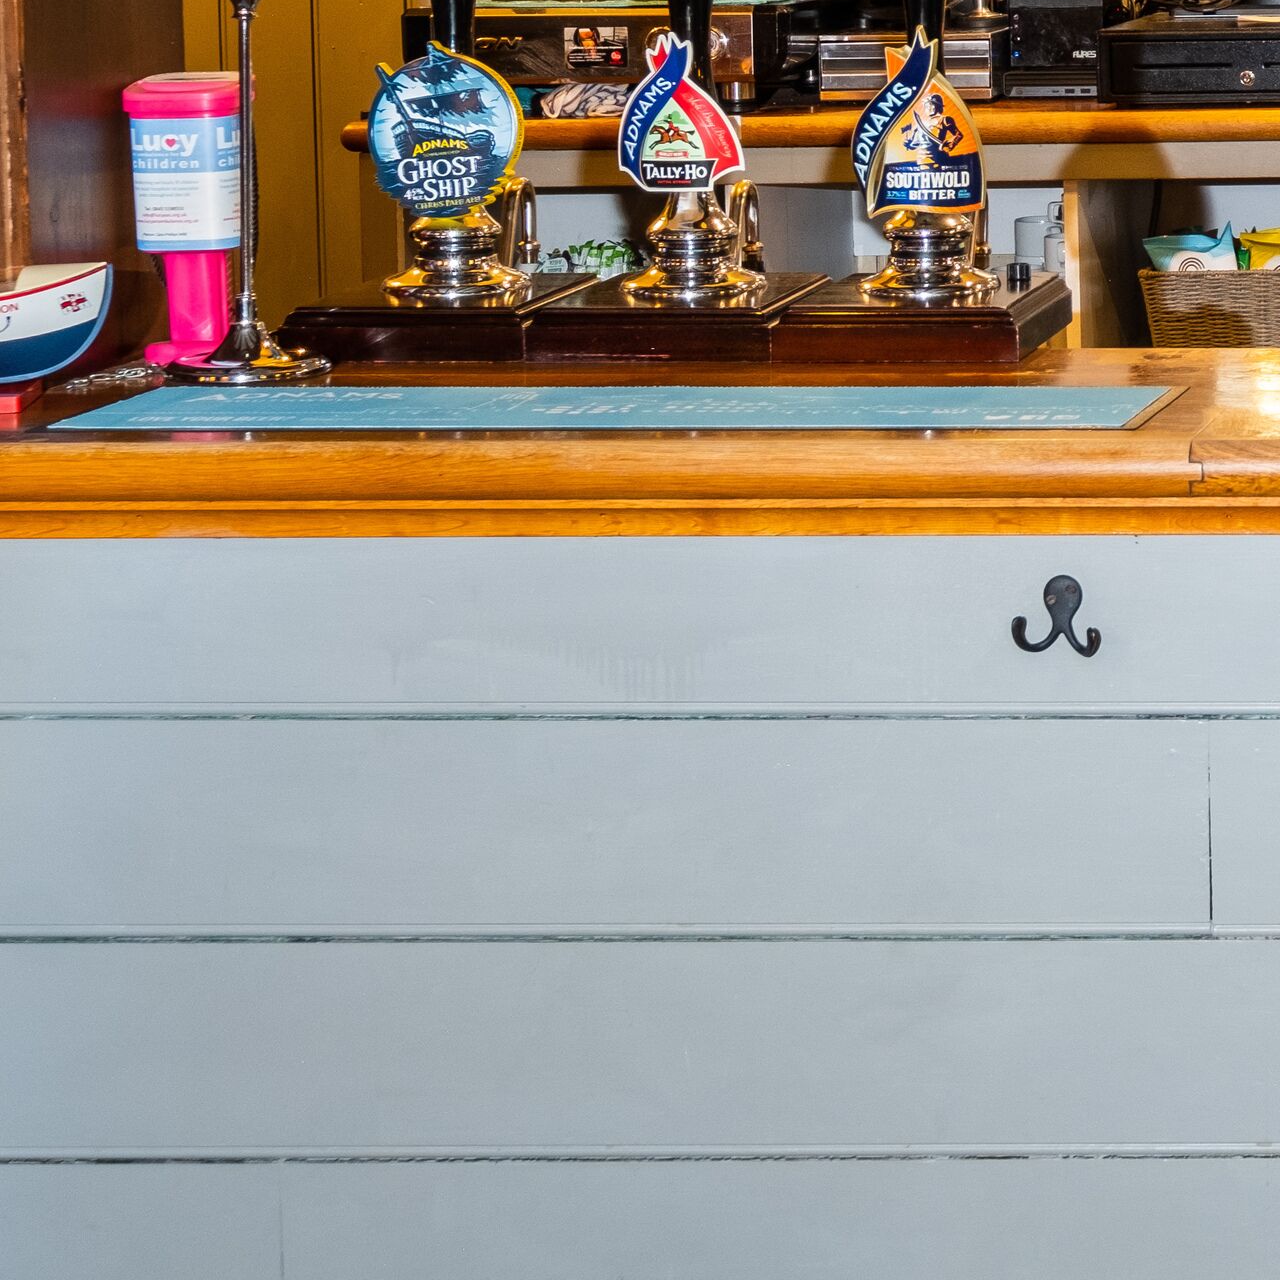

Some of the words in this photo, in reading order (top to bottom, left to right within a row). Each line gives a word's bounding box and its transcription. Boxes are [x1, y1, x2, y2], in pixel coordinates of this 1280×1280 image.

[131, 128, 198, 157] Lucy
[855, 82, 917, 187] ADNAMS.
[133, 159, 199, 169] children
[397, 156, 482, 185] GHOST
[643, 163, 708, 180] TALLY-HO
[423, 177, 476, 201] SHIP
[886, 171, 970, 189] SOUTHWOLD
[909, 189, 955, 200] BITTER
